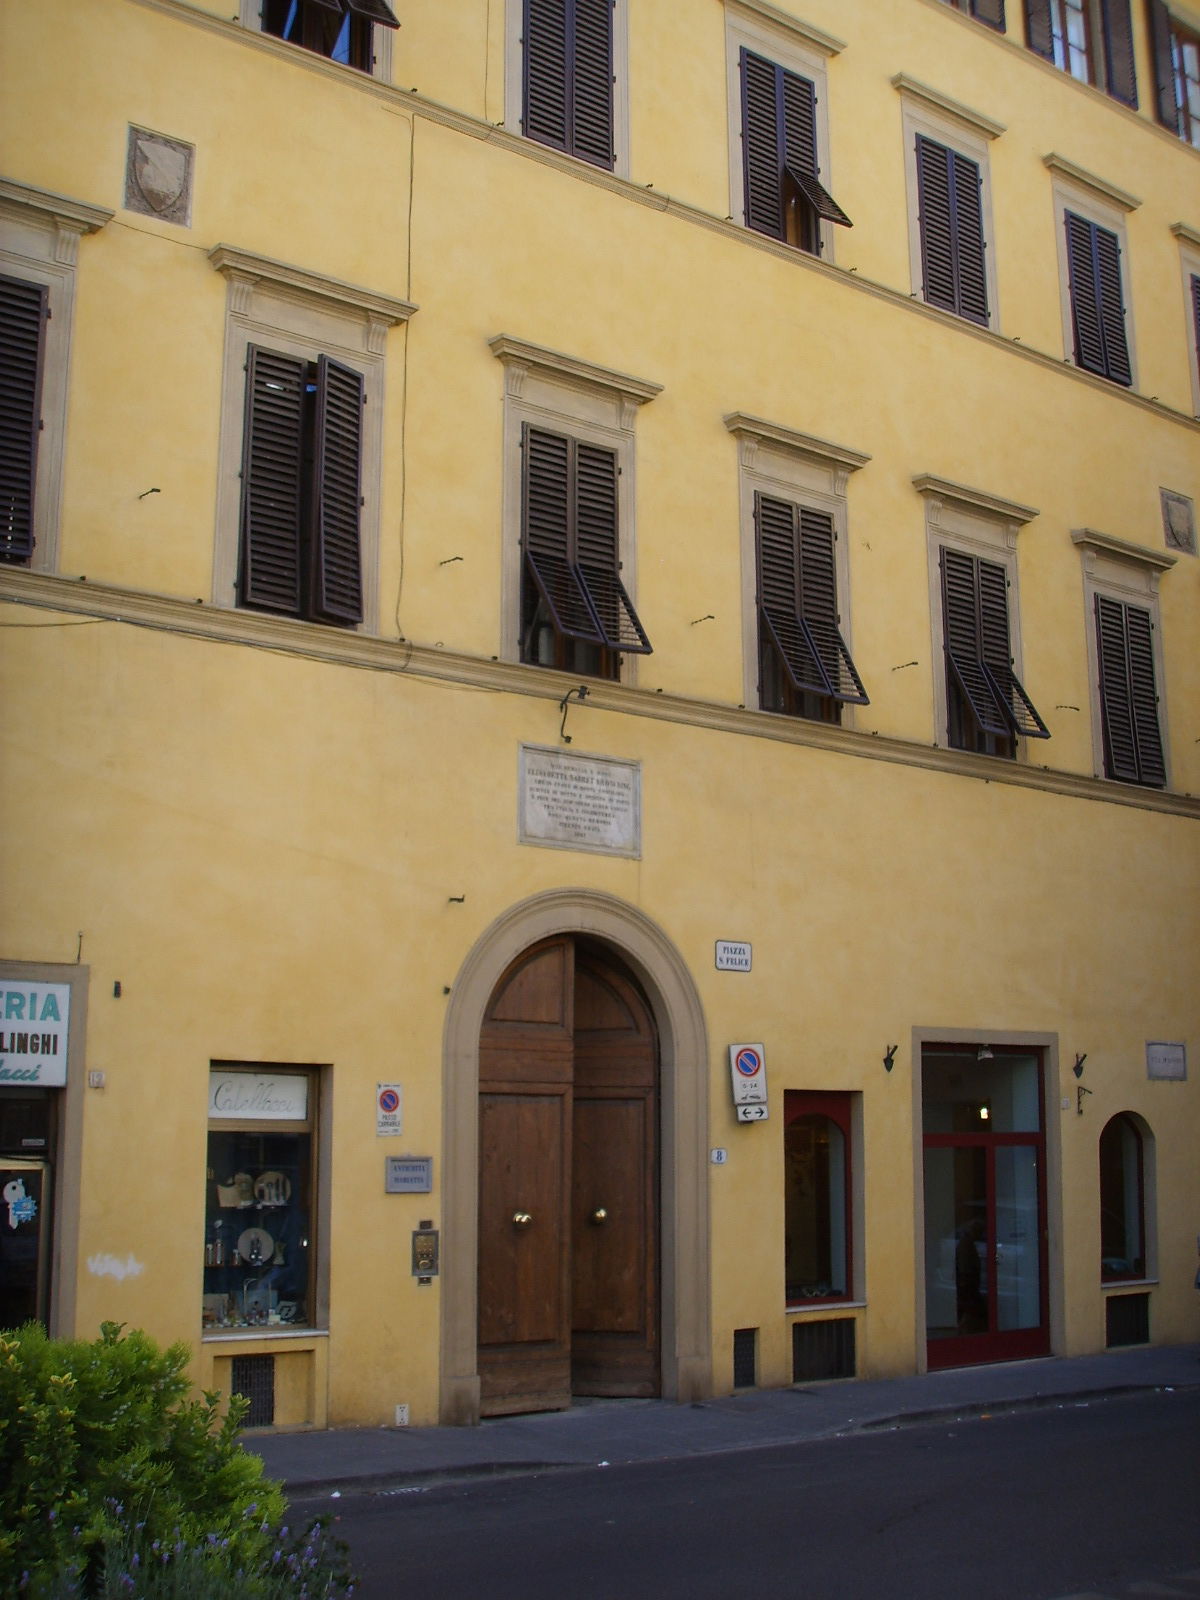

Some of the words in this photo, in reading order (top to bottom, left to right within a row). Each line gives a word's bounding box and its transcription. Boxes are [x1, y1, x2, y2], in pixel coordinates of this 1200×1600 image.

[723, 946, 746, 955] PIAZZA
[726, 957, 749, 967] FELICE
[0, 990, 61, 1021] RIA
[716, 1150, 722, 1161] 8
